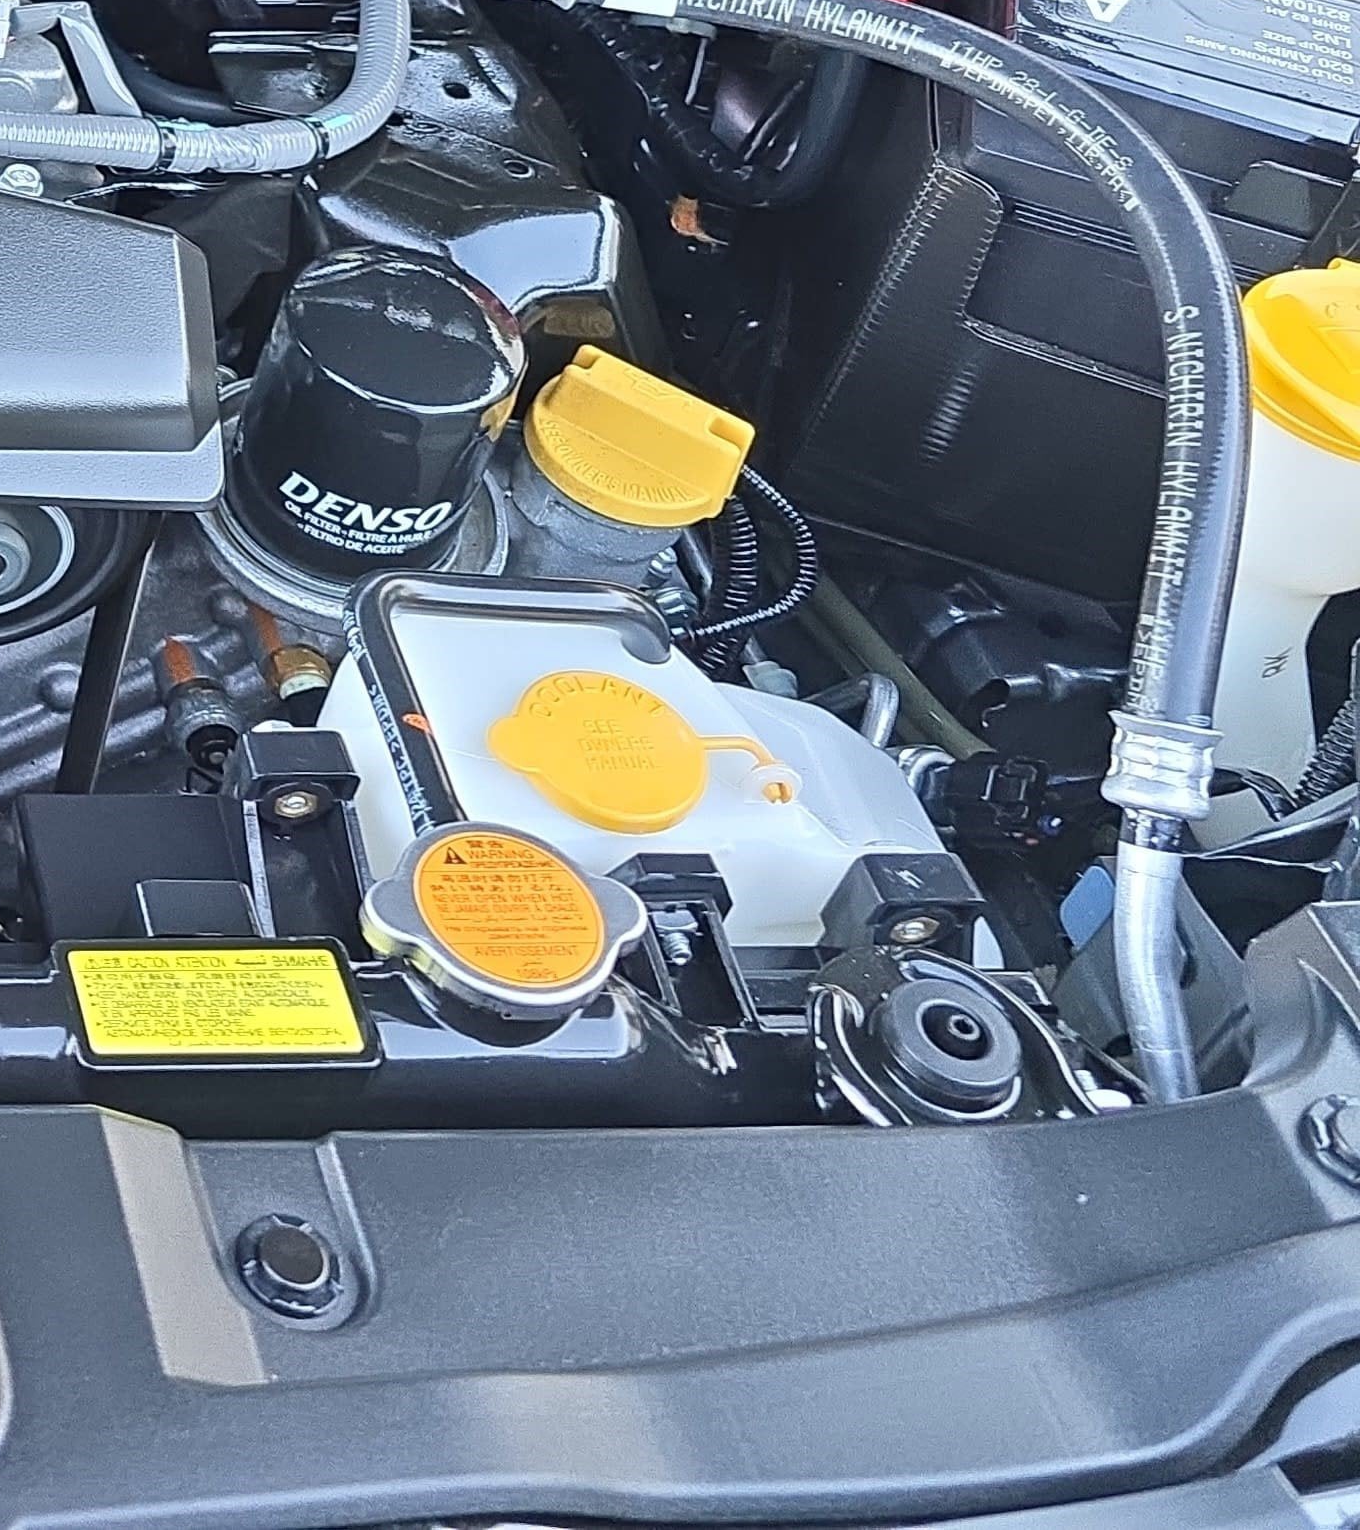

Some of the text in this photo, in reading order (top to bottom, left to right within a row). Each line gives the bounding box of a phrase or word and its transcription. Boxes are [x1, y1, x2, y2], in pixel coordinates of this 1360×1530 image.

[1262, 29, 1353, 60] GROUP SIZE
[1312, 29, 1351, 48] LN2
[1184, 34, 1354, 85] COLD CRANKING AMPS
[1253, 40, 1354, 74] 620 AMPS
[1165, 331, 1205, 448] NICHIRIN
[278, 471, 453, 533] DENSO
[303, 511, 341, 533] FILTER
[348, 529, 387, 544] FILTRE
[304, 525, 345, 547] FILTRO
[345, 539, 363, 552] DE
[529, 676, 670, 718] COOLANT
[465, 849, 535, 860] WARNING
[432, 894, 469, 903] NEVER
[474, 894, 508, 903] OPEN
[511, 894, 548, 903] WHEN
[474, 945, 578, 957] AVERTISSEMENT
